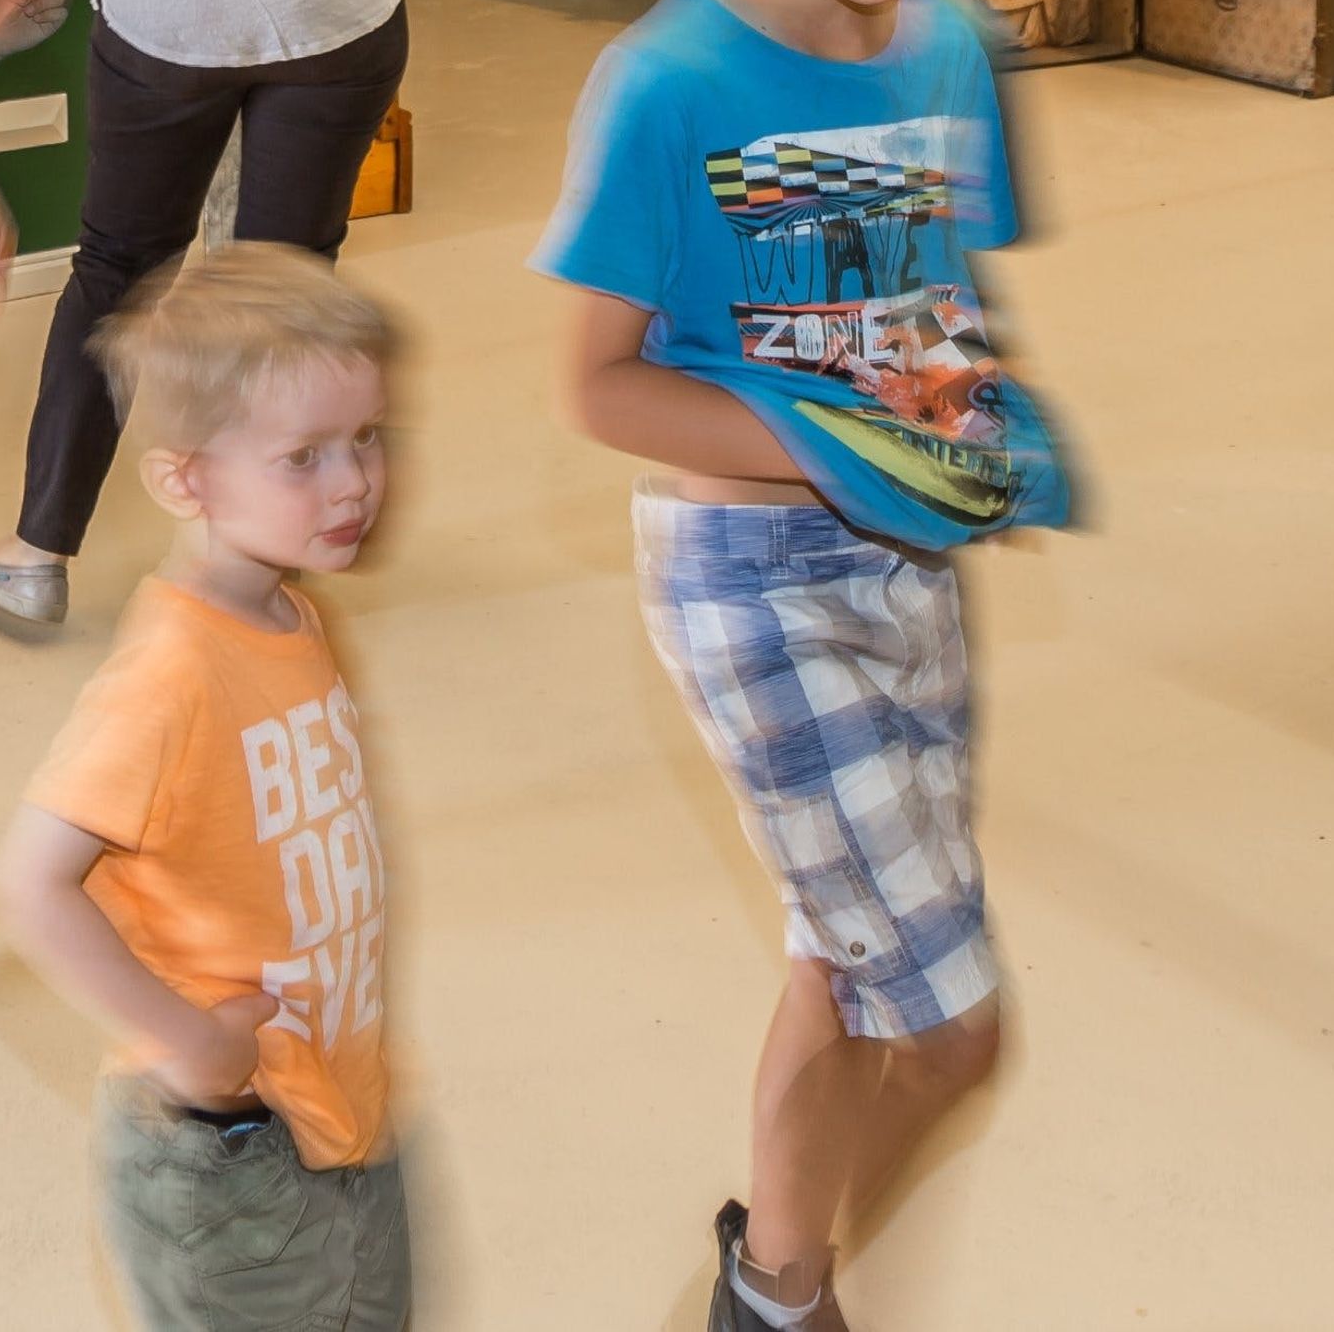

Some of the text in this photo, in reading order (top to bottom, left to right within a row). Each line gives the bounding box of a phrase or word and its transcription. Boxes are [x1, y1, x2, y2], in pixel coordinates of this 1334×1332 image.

[733, 211, 931, 306] WAVE
[751, 311, 895, 364] ZONE
[241, 674, 363, 844] BES
[261, 912, 383, 1052] EVE
